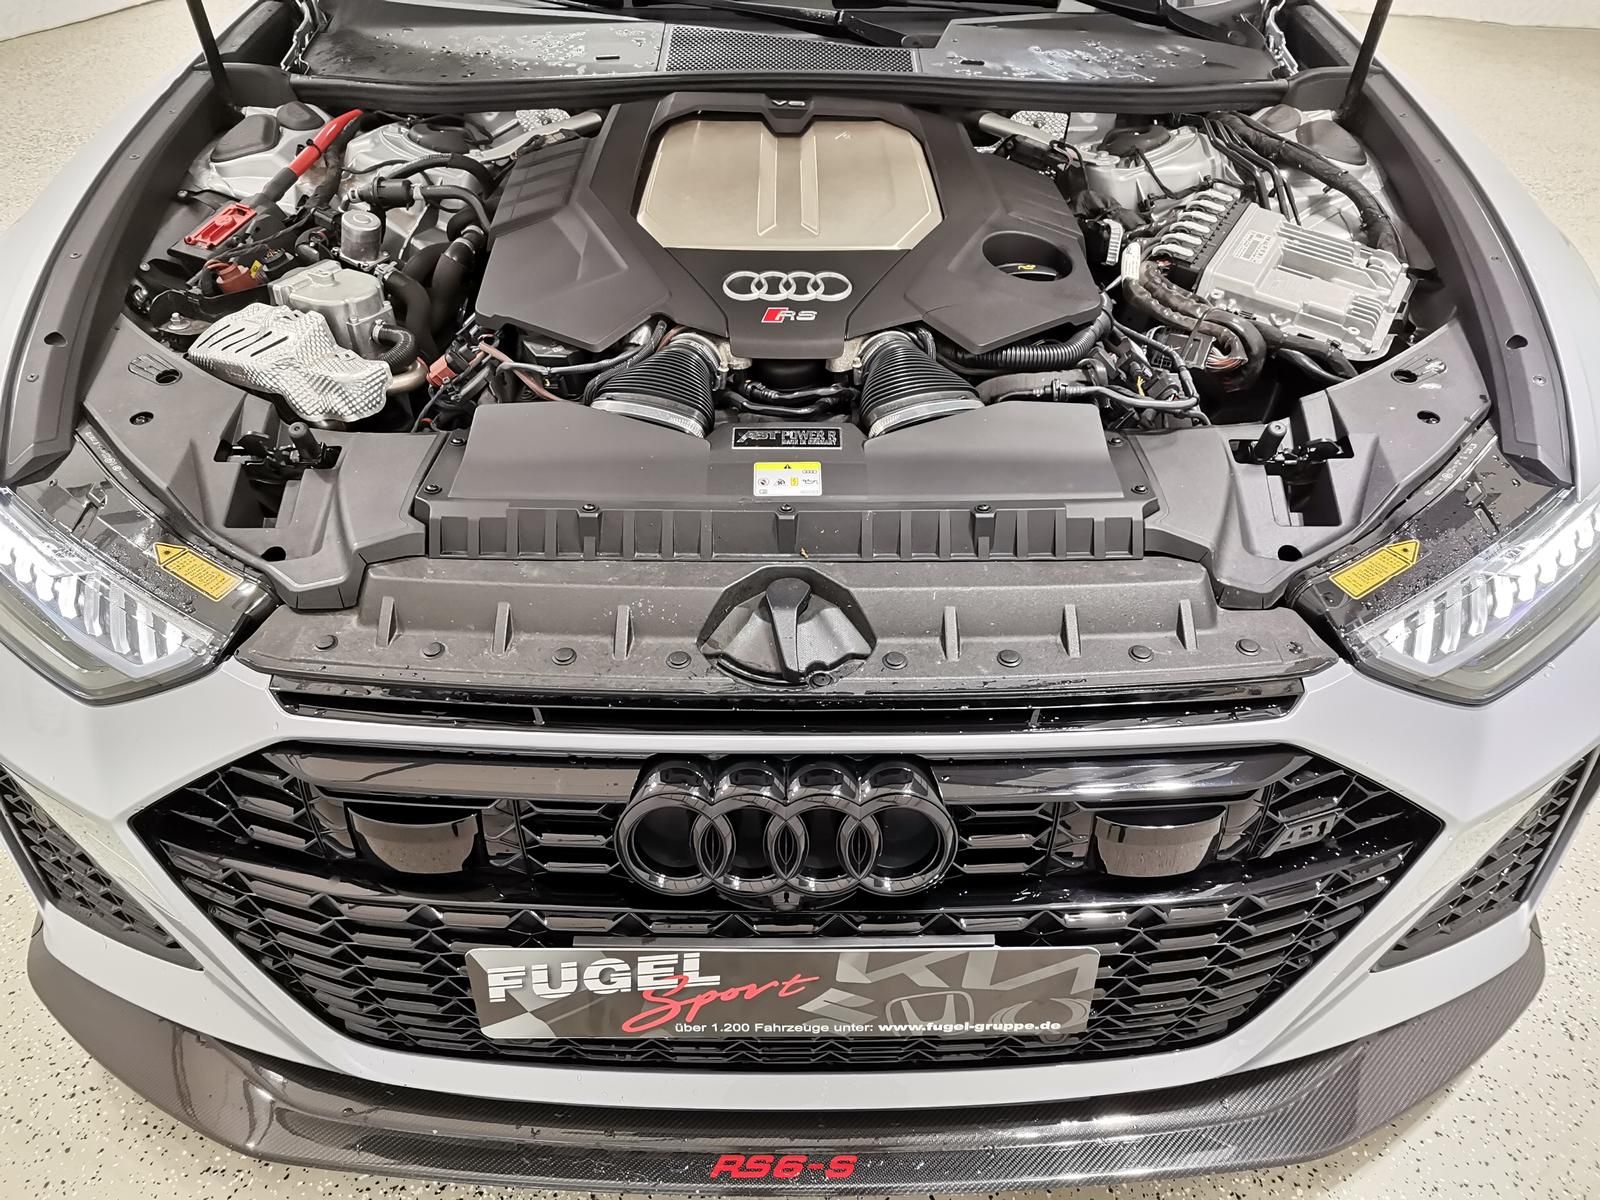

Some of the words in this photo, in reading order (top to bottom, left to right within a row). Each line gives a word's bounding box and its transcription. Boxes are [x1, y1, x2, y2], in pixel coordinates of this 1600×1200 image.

[774, 310, 818, 321] RS
[781, 430, 824, 441] POWER
[827, 430, 837, 441] R
[1260, 814, 1337, 859] ABT
[487, 952, 721, 1003] FUGEL
[621, 973, 822, 1033] Sport
[674, 1022, 708, 1033] über
[711, 1022, 750, 1033] 1.200
[754, 1022, 830, 1035] Fahrzeuge
[833, 1022, 874, 1033] unter:
[878, 1021, 1062, 1033] www.fugel-gruppe.de
[709, 1154, 858, 1179] RS6-S
